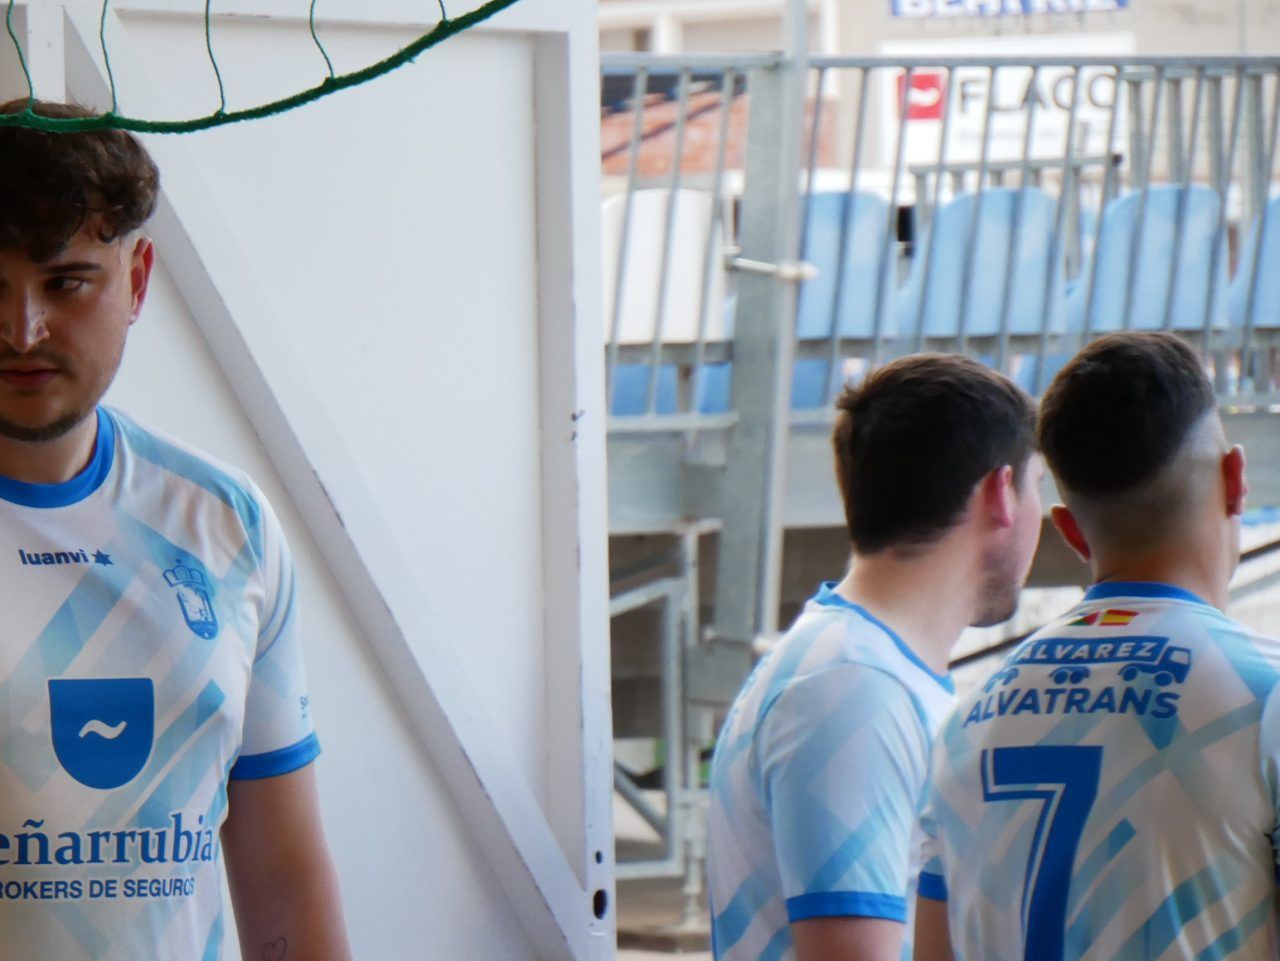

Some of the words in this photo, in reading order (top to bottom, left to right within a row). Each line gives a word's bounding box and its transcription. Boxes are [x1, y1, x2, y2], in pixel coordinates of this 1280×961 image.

[18, 549, 89, 565] luanvi
[1020, 641, 1158, 660] ALVAREZ
[963, 687, 1181, 728] ALVATRANS
[89, 879, 118, 898] DE
[123, 877, 195, 898] SEGUROS
